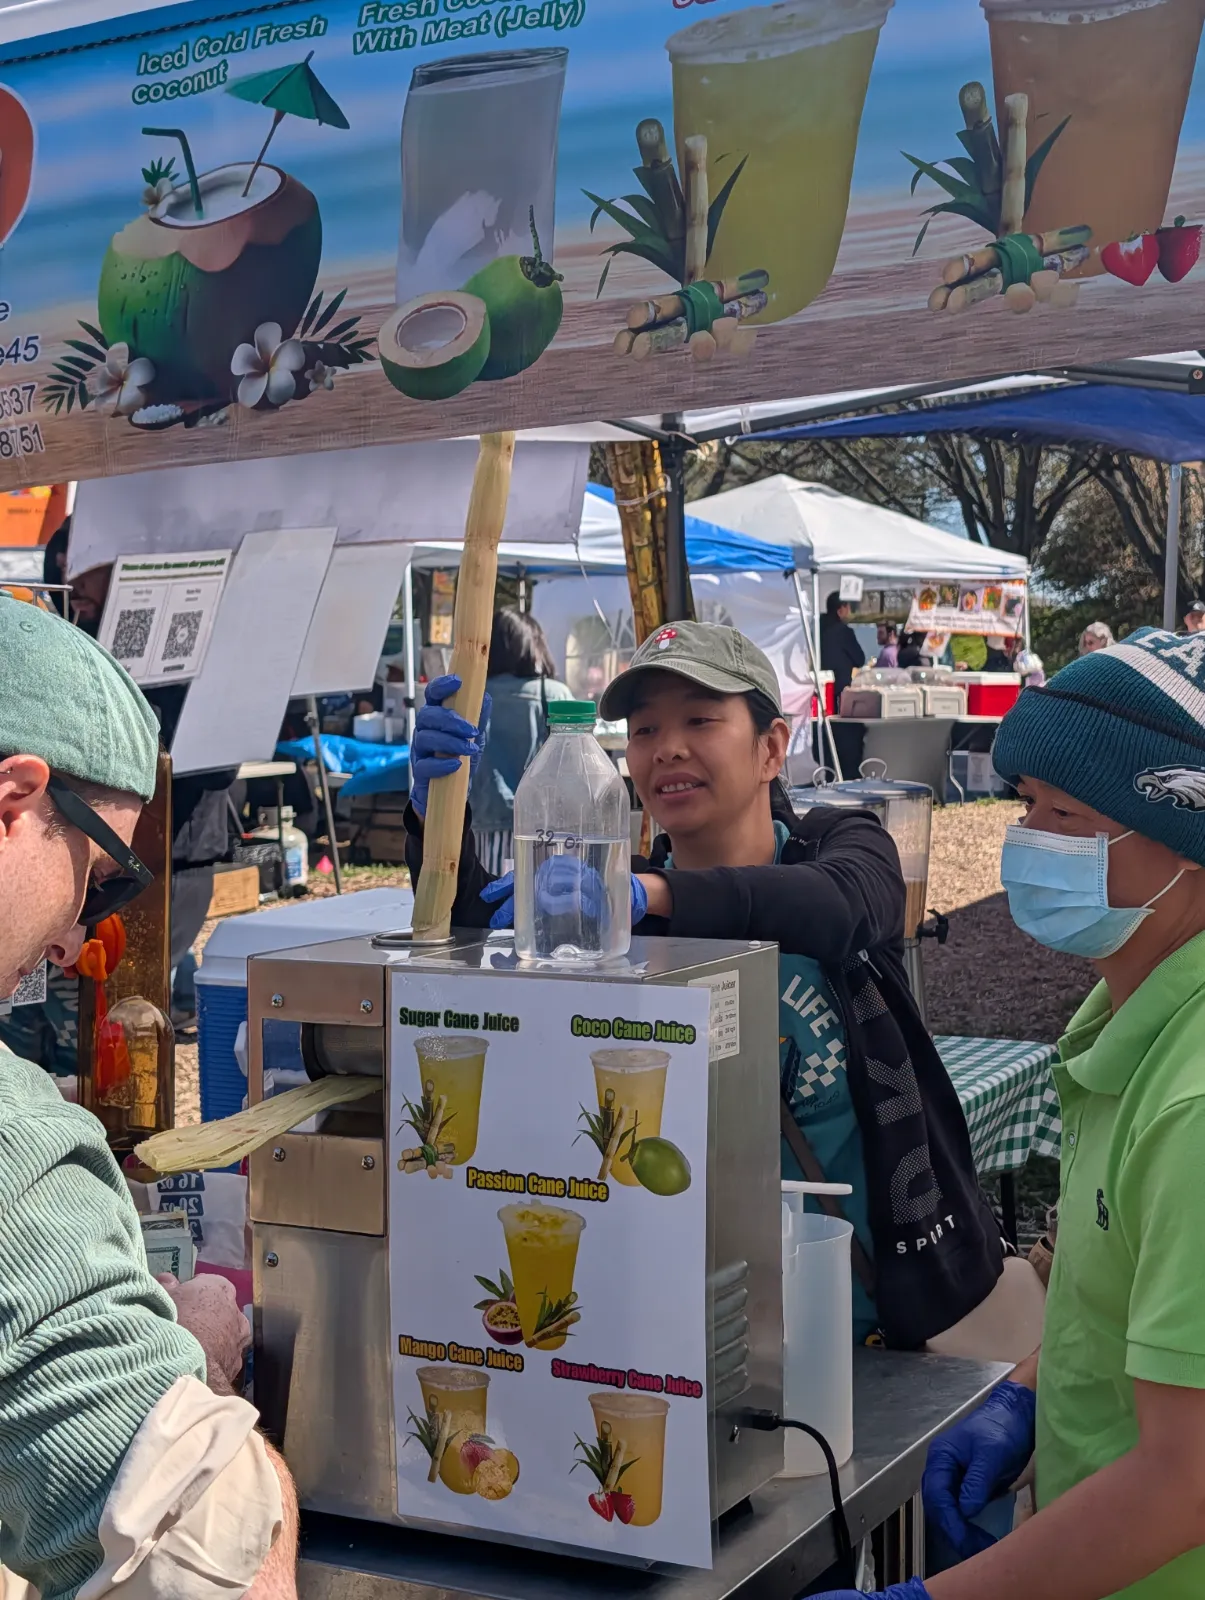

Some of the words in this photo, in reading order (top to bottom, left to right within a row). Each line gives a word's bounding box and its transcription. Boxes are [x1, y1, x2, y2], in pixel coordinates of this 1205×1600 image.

[355, 27, 415, 53] With
[422, 13, 491, 43] Meat
[495, 0, 585, 36] (Jelly)
[360, 0, 436, 25] Fresh
[139, 44, 187, 74] Iced
[194, 30, 247, 60] Cold
[254, 16, 326, 47] Fresh
[133, 61, 227, 103] coconut
[533, 828, 557, 850] 32
[399, 1006, 441, 1028] Sugar
[443, 1009, 479, 1030] Cane
[482, 1012, 520, 1033] Juice
[781, 974, 840, 1038] LIFE
[572, 1015, 610, 1038] Coco
[613, 1017, 652, 1041] Cane
[654, 1020, 695, 1044] Juice
[467, 1166, 525, 1193] Passion
[528, 1173, 566, 1198] Cane
[568, 1176, 608, 1201] Juice
[896, 1214, 956, 1255] SPORT
[399, 1334, 446, 1361] Mango
[448, 1341, 484, 1366] Cane
[486, 1347, 523, 1372] Juice
[552, 1358, 626, 1388] Strawberry
[627, 1369, 663, 1392] Cane
[664, 1374, 702, 1398] Juice
